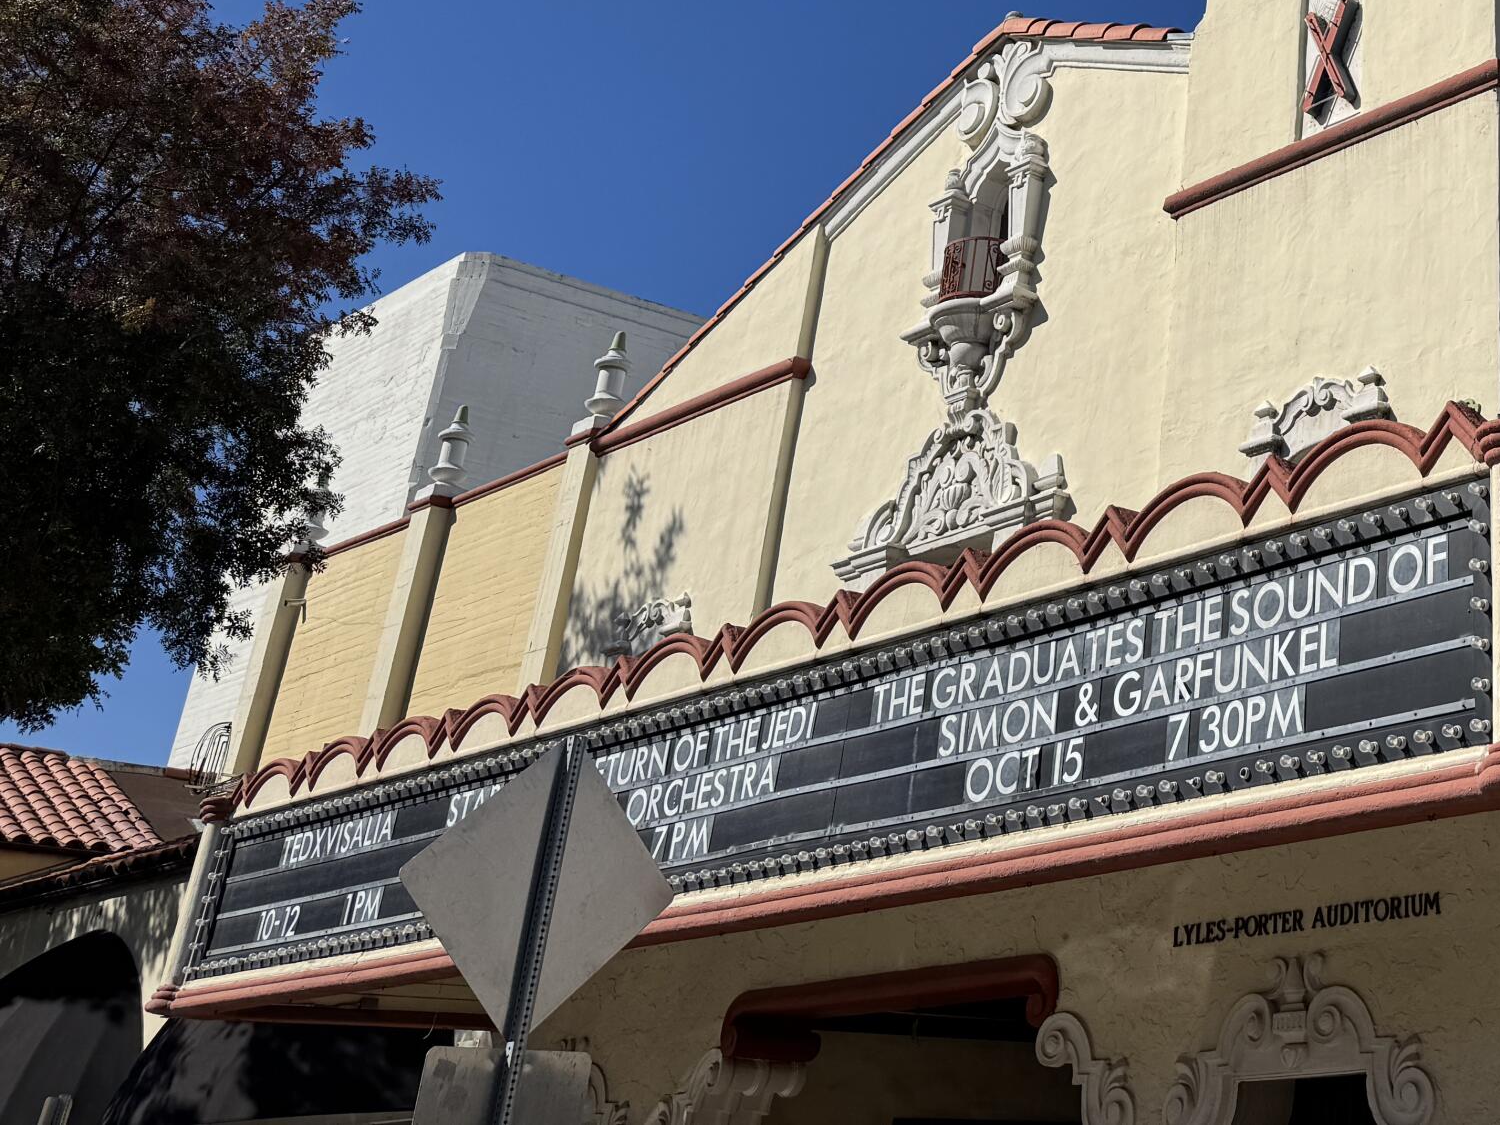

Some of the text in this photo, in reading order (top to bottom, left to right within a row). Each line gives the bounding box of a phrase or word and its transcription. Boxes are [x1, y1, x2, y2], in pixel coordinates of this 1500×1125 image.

[874, 534, 1448, 723] THE GRADUATES THE SOUND OF
[938, 622, 1337, 757] SIMON & GARFUNKEL
[673, 730, 709, 772] OF
[714, 718, 761, 762] THE
[762, 702, 817, 750] JEDI
[966, 746, 1040, 802] OCT
[1053, 737, 1084, 786] 15
[626, 757, 774, 826] ORCHESTRA
[282, 811, 392, 865] TEDXVISALIA
[257, 906, 300, 941] 10-12
[1173, 891, 1442, 947] LYLES-PORTER AUDITORIUM
